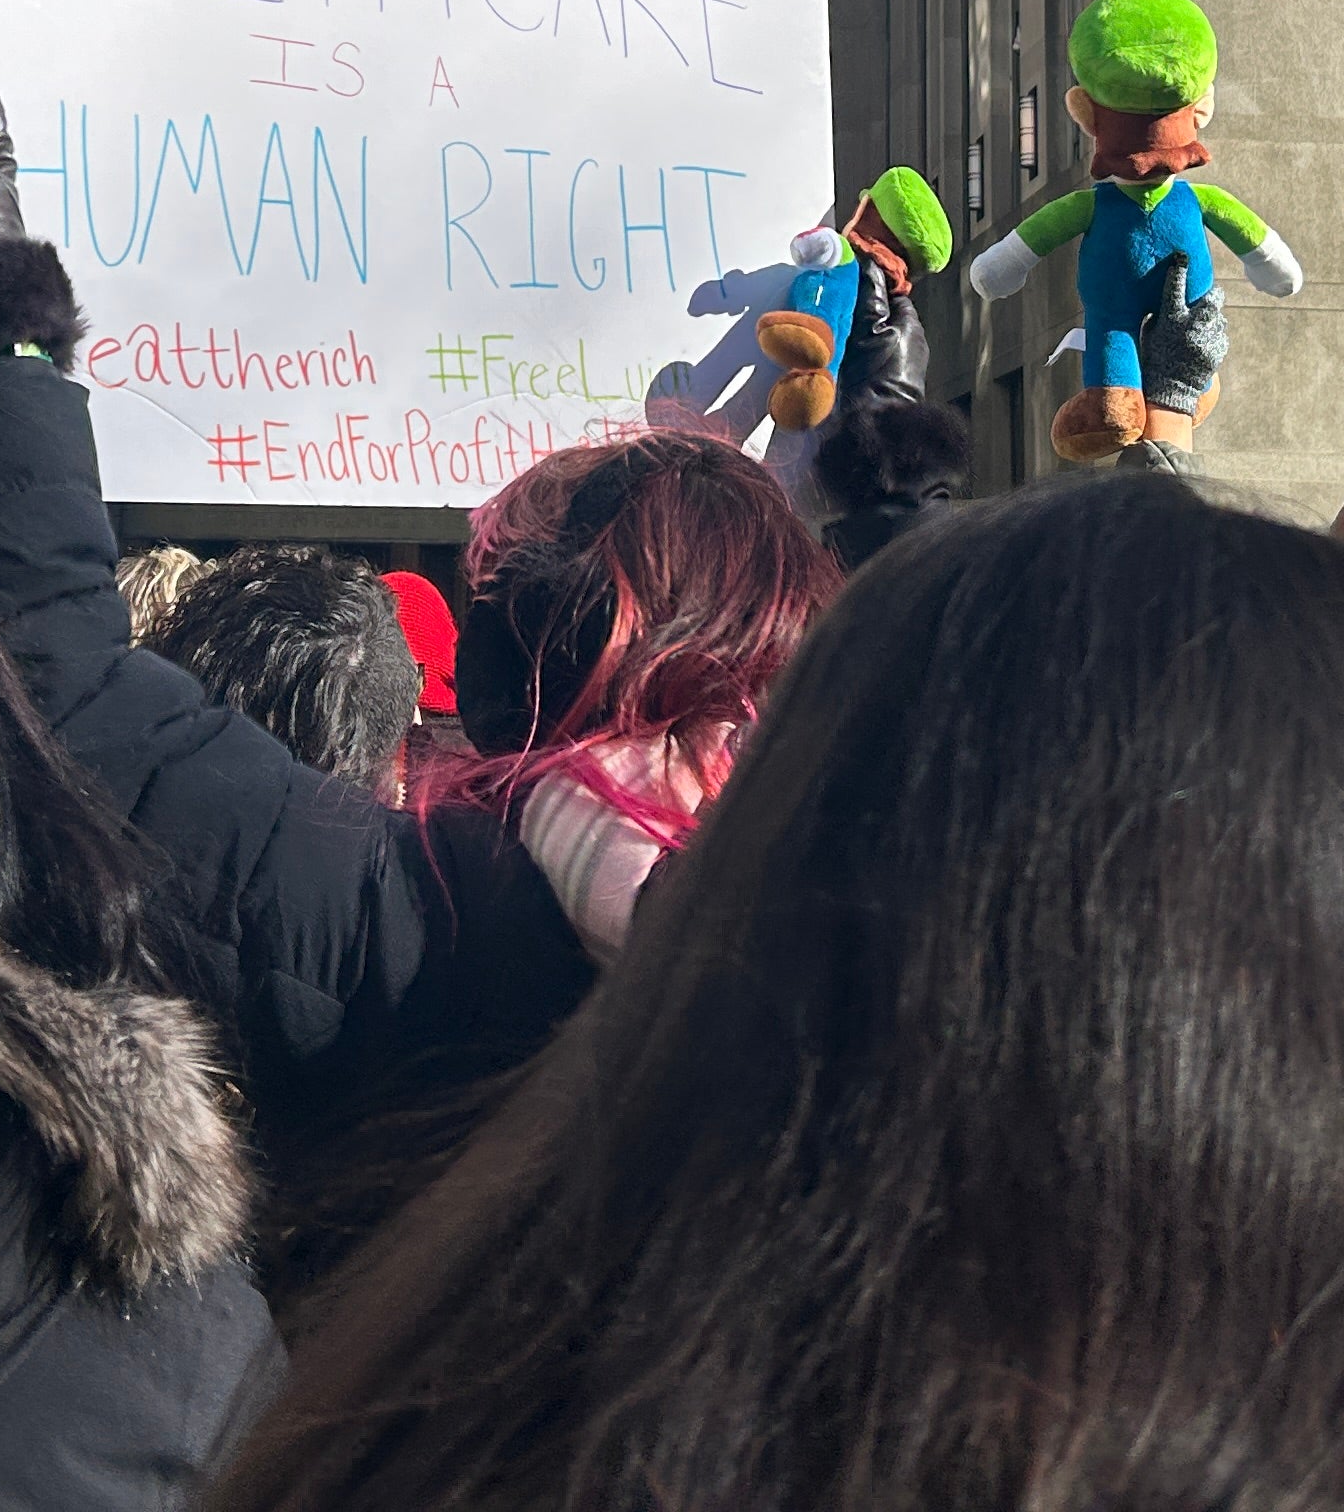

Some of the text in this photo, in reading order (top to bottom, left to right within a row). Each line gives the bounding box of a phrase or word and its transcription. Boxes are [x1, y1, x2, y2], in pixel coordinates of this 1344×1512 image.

[248, 32, 461, 108] IS A
[16, 98, 747, 299] HUMAN RIGHT
